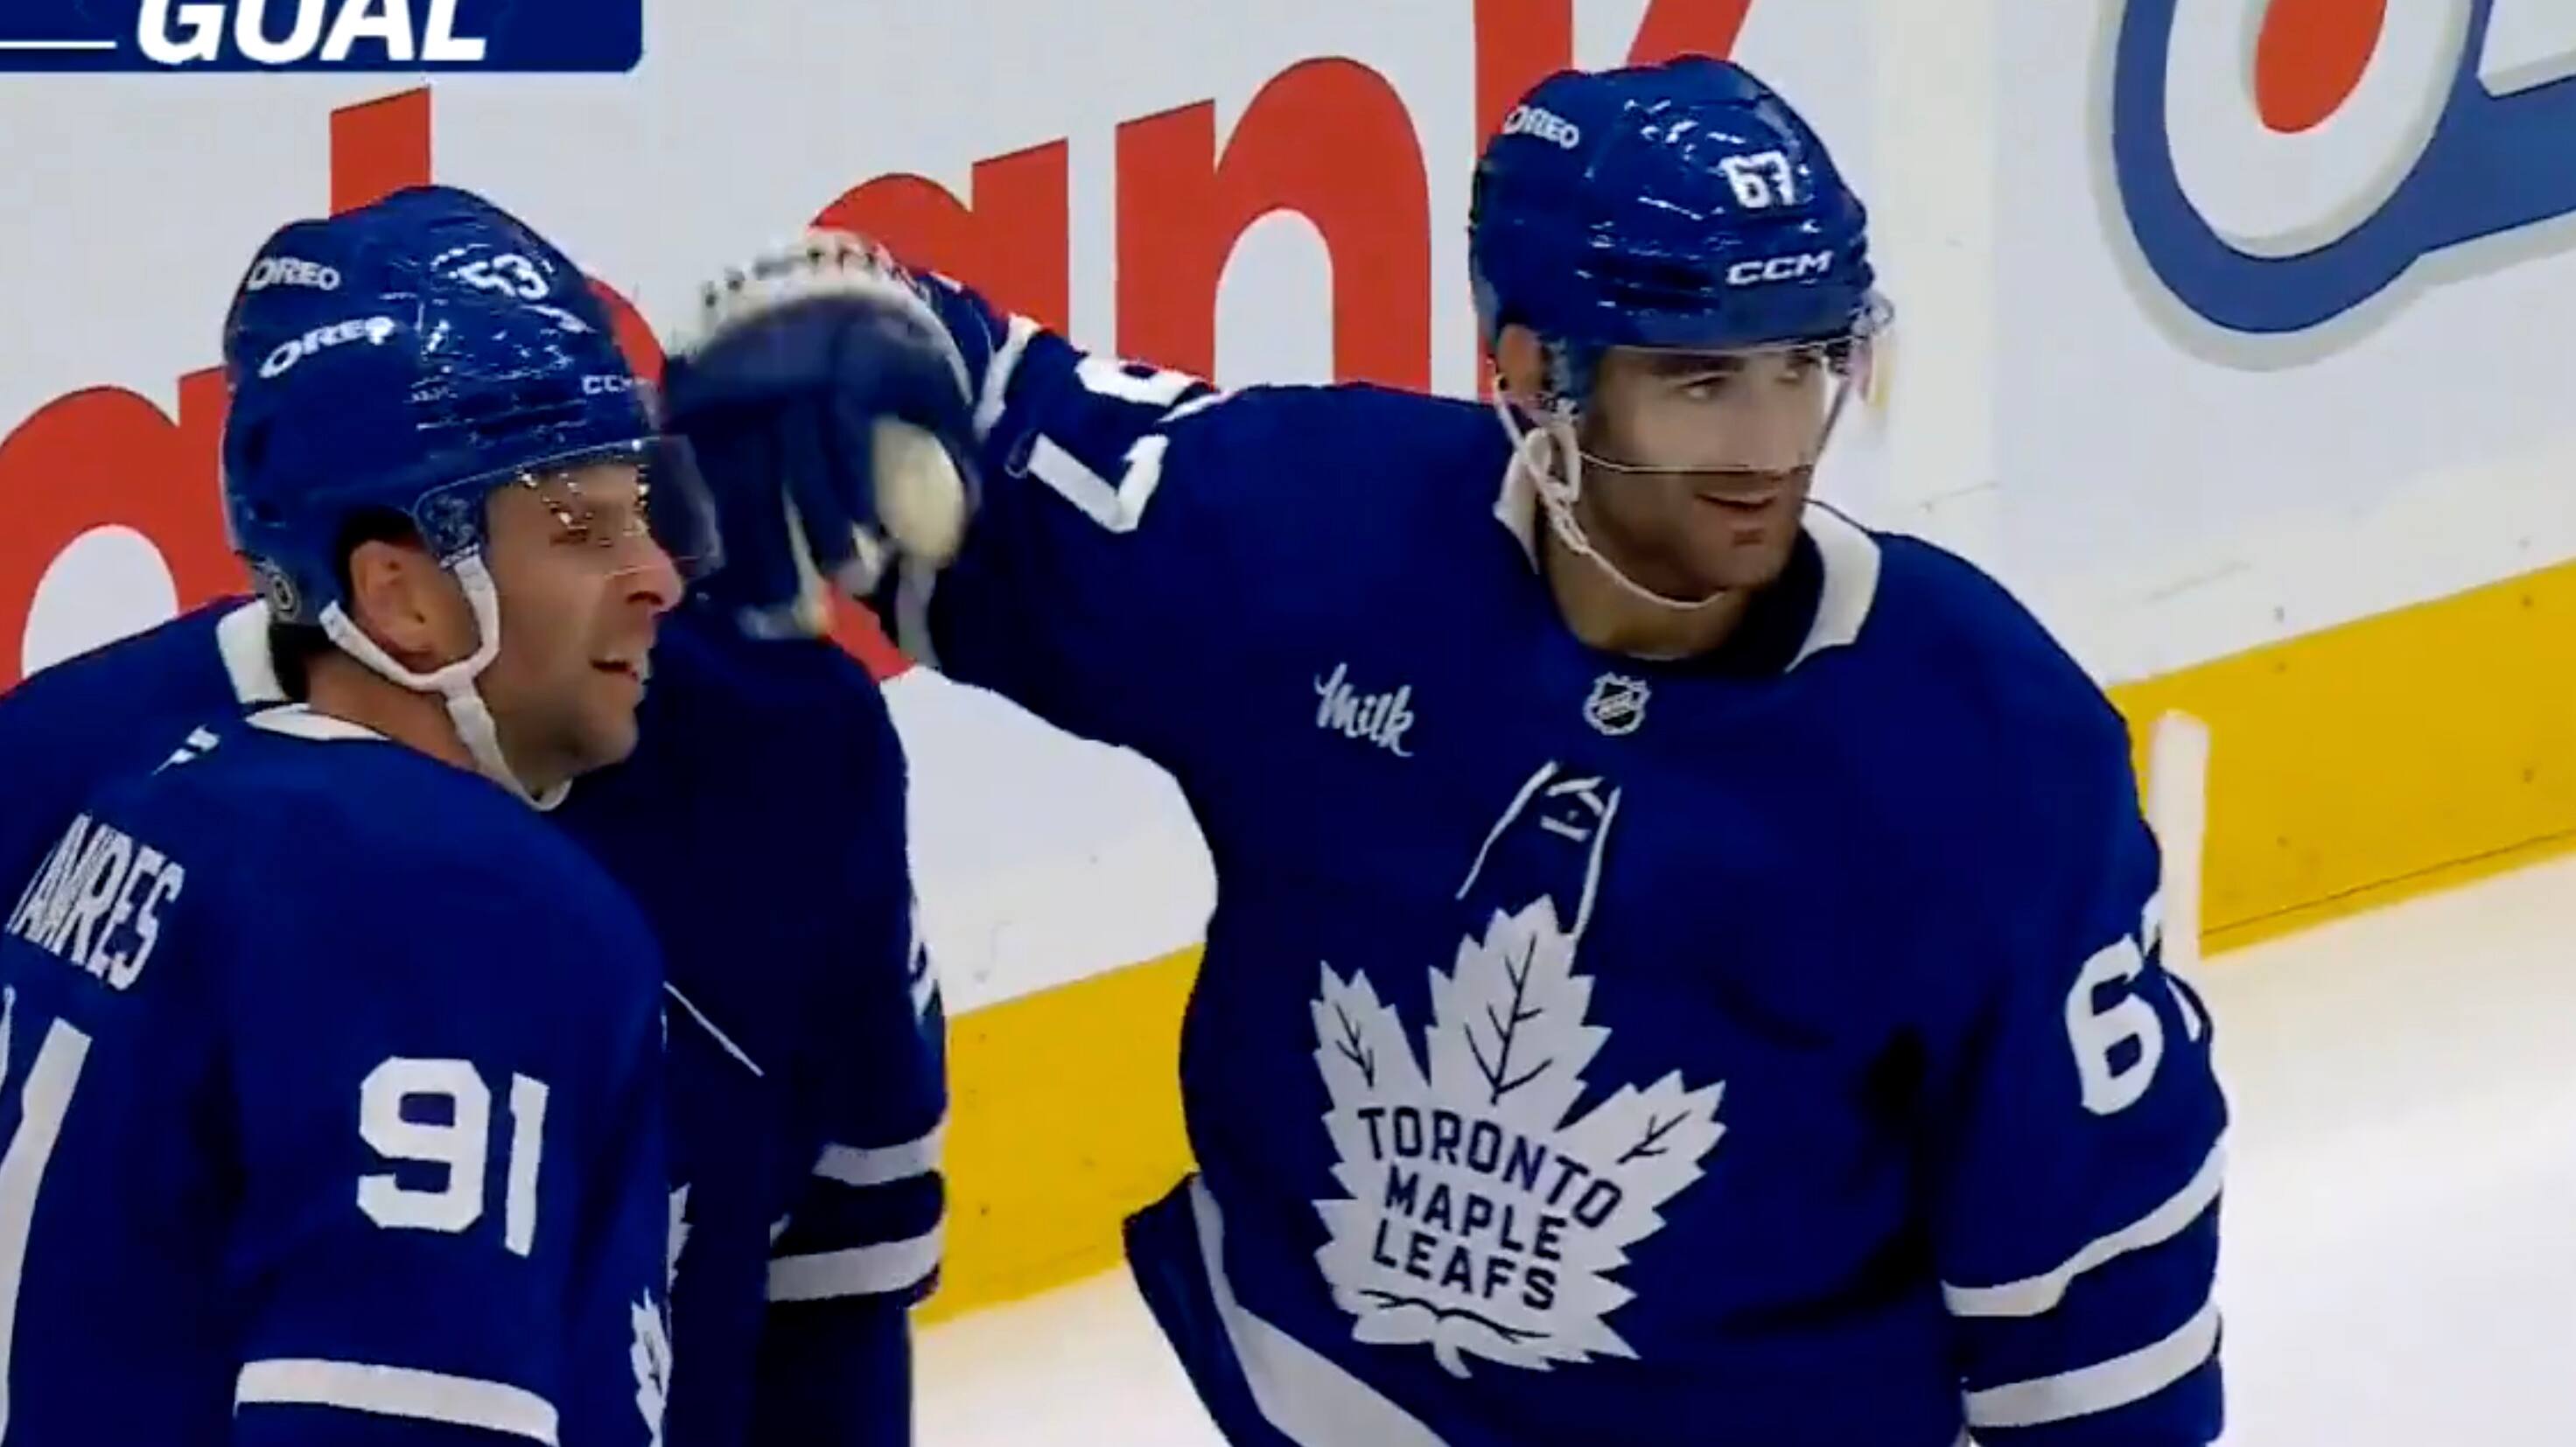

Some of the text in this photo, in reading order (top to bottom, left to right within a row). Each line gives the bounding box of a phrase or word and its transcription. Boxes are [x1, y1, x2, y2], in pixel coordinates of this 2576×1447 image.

[1502, 105, 1580, 150] OREO
[1718, 150, 1796, 209] 67
[247, 256, 341, 291] OREO
[1726, 250, 1834, 287] CCM
[582, 374, 634, 395] CC
[1314, 662, 1415, 757] Milk
[357, 1056, 550, 1257] 91
[1357, 1106, 1623, 1229] TORONTO
[1384, 1163, 1568, 1262] MAPLE
[1372, 1217, 1557, 1311] LEAFS
